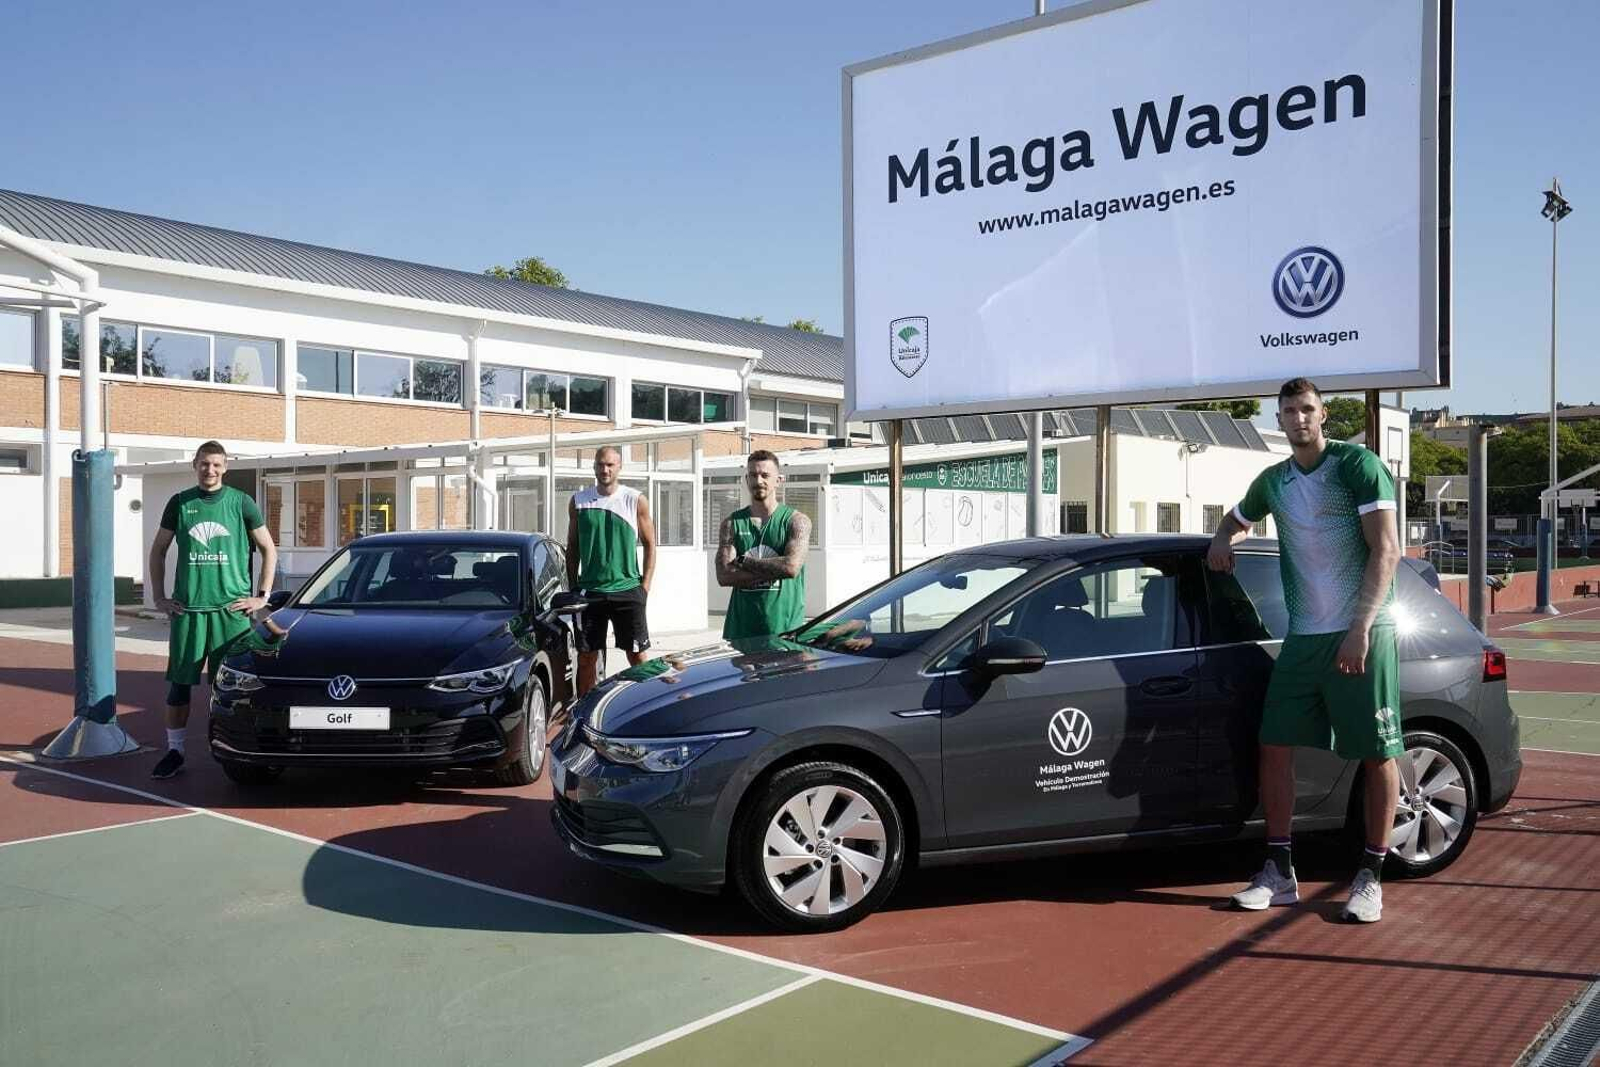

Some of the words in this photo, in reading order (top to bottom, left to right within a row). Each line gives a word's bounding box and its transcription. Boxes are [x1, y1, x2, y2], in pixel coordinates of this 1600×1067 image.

[888, 130, 1094, 203] Málaga
[1112, 74, 1366, 160] Wagen
[978, 180, 1235, 234] www.malagawagen.es
[1260, 330, 1359, 348] Volkswagen
[863, 470, 890, 485] Unica
[189, 550, 228, 562] Unicaja
[327, 713, 353, 723] Golf
[1040, 763, 1073, 775] Málaga
[1073, 759, 1105, 770] Wagen
